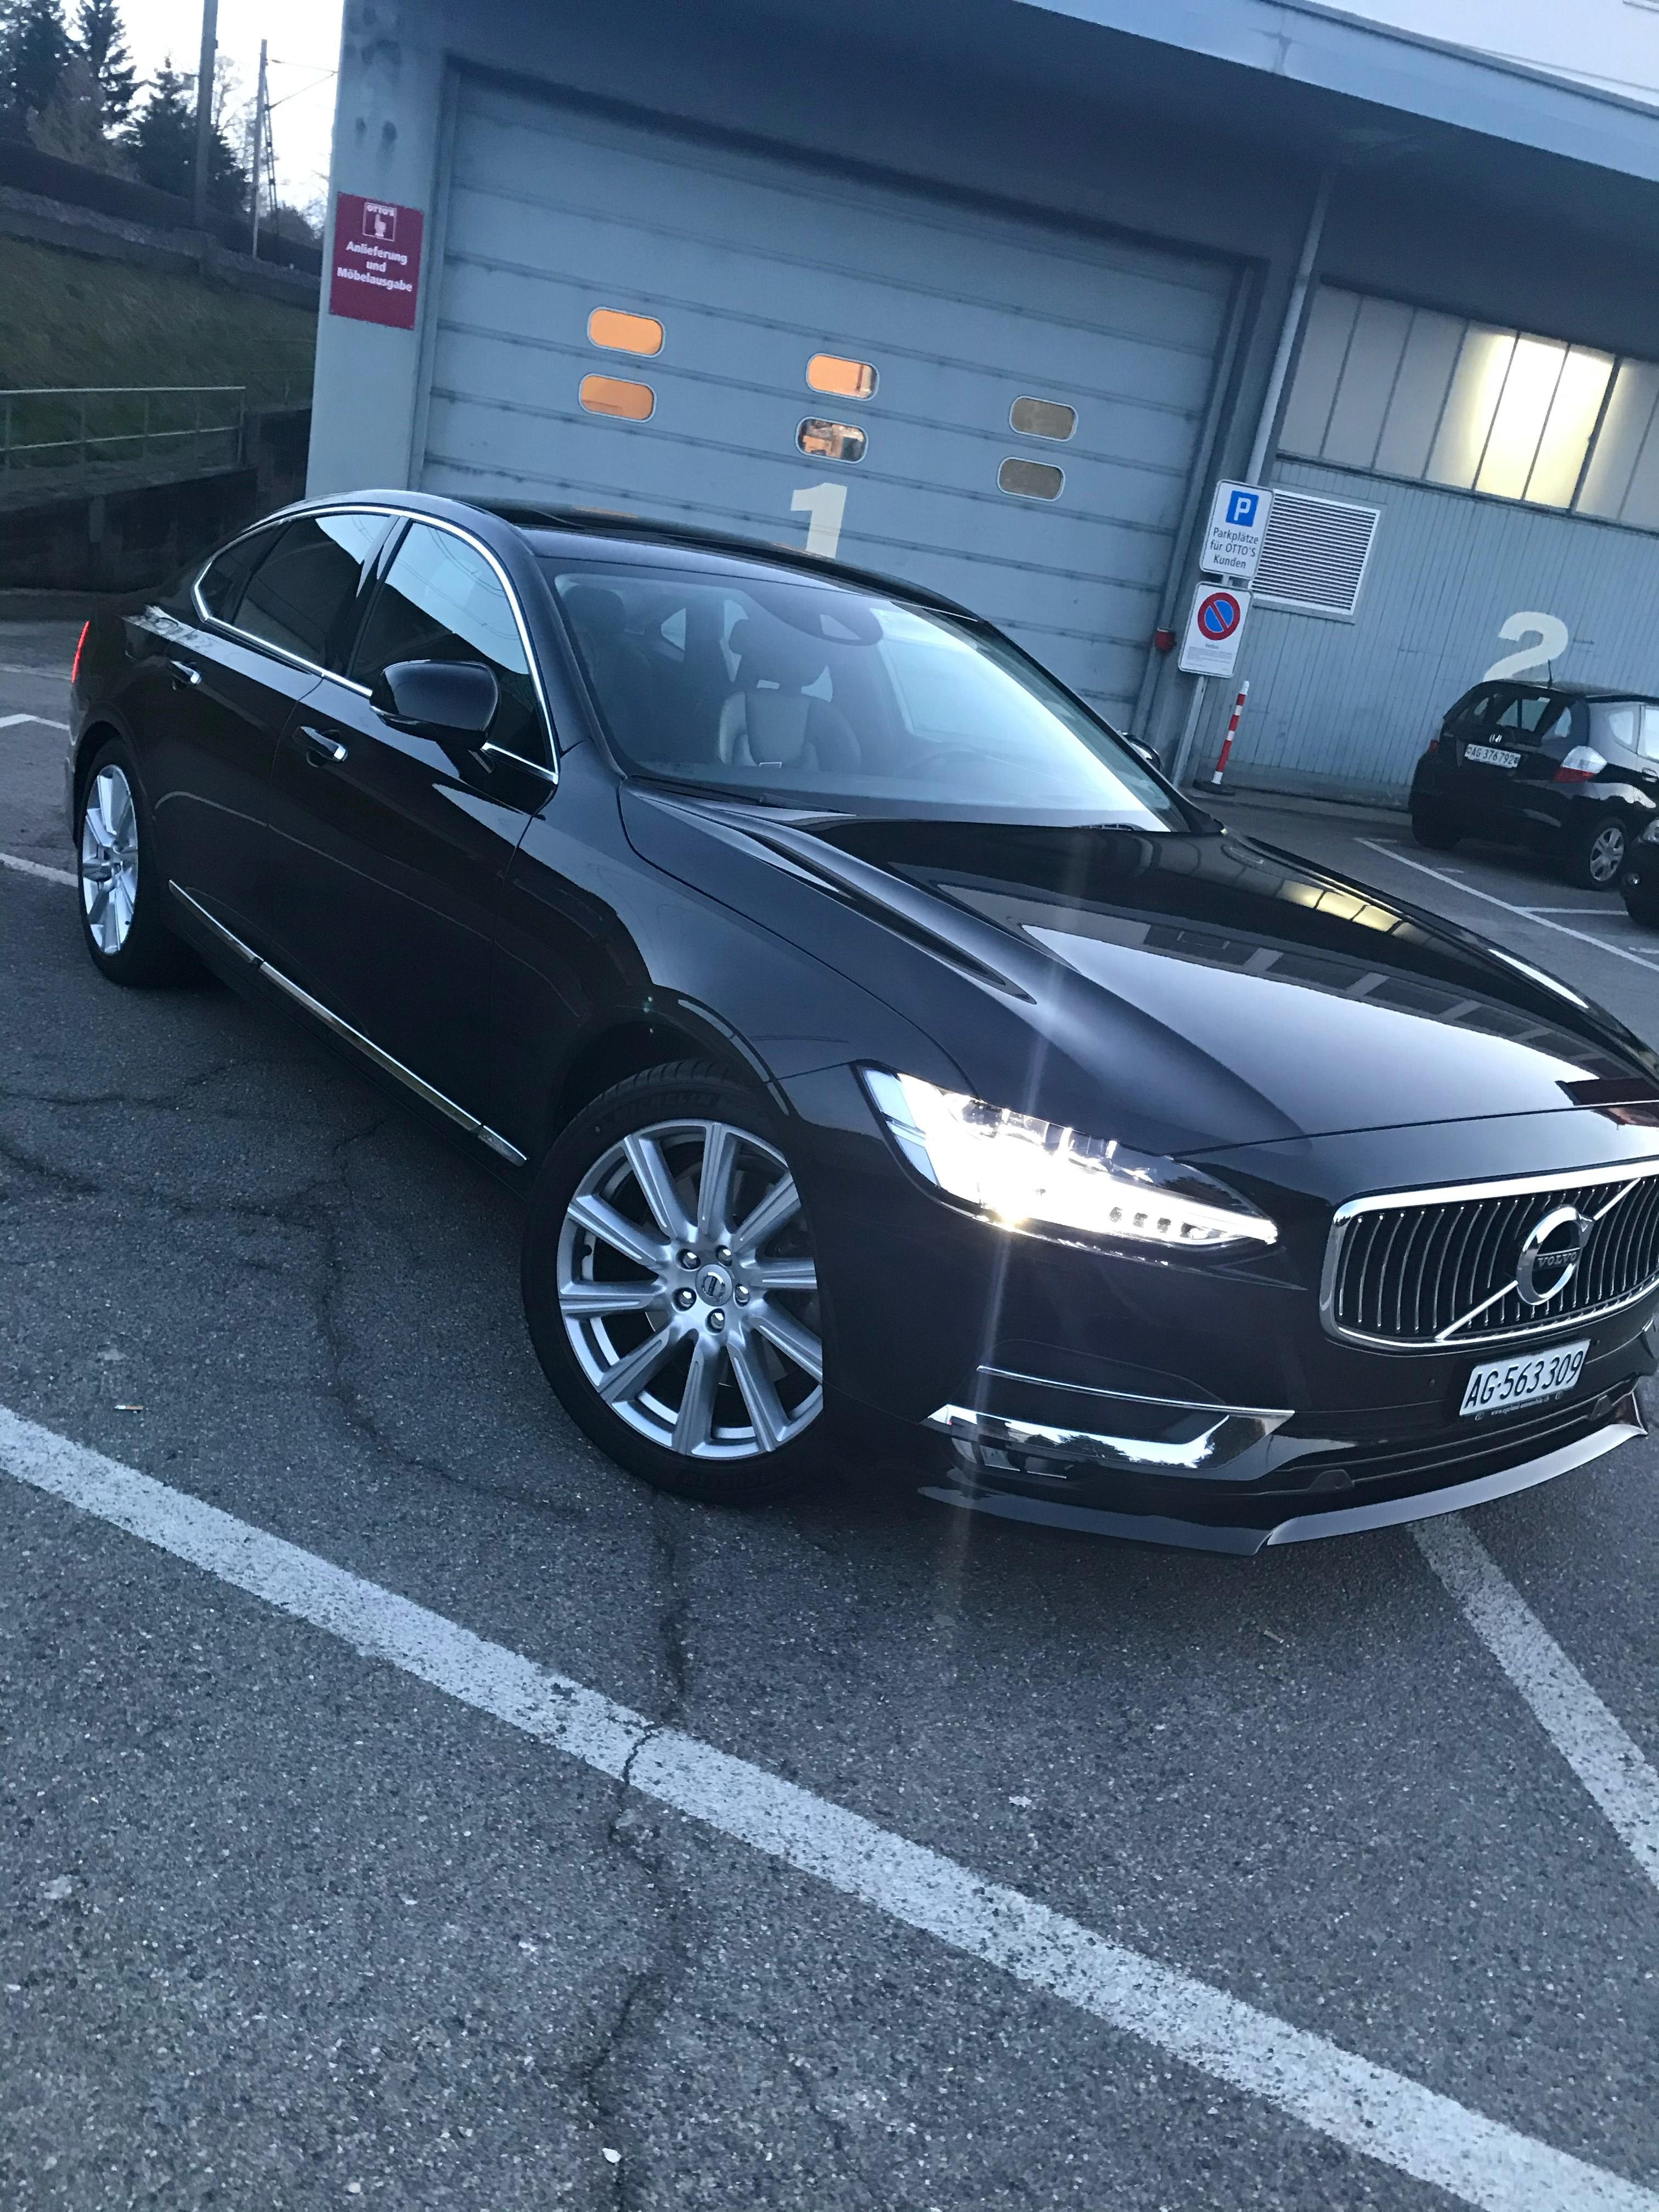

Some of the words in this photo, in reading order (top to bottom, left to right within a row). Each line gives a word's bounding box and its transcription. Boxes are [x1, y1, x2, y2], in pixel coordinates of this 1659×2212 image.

[346, 241, 408, 266] Anlieferung
[366, 261, 387, 273] und
[337, 267, 413, 292] Möbelausgabe
[1233, 496, 1251, 521] P
[791, 482, 848, 559] 1
[1213, 527, 1259, 545] Parkplätze
[1210, 539, 1223, 551] für
[1225, 543, 1256, 557] OTTO'S
[1213, 554, 1246, 569] Kunden
[1482, 611, 1569, 682] 2
[1537, 1251, 1577, 1268] VOLVO
